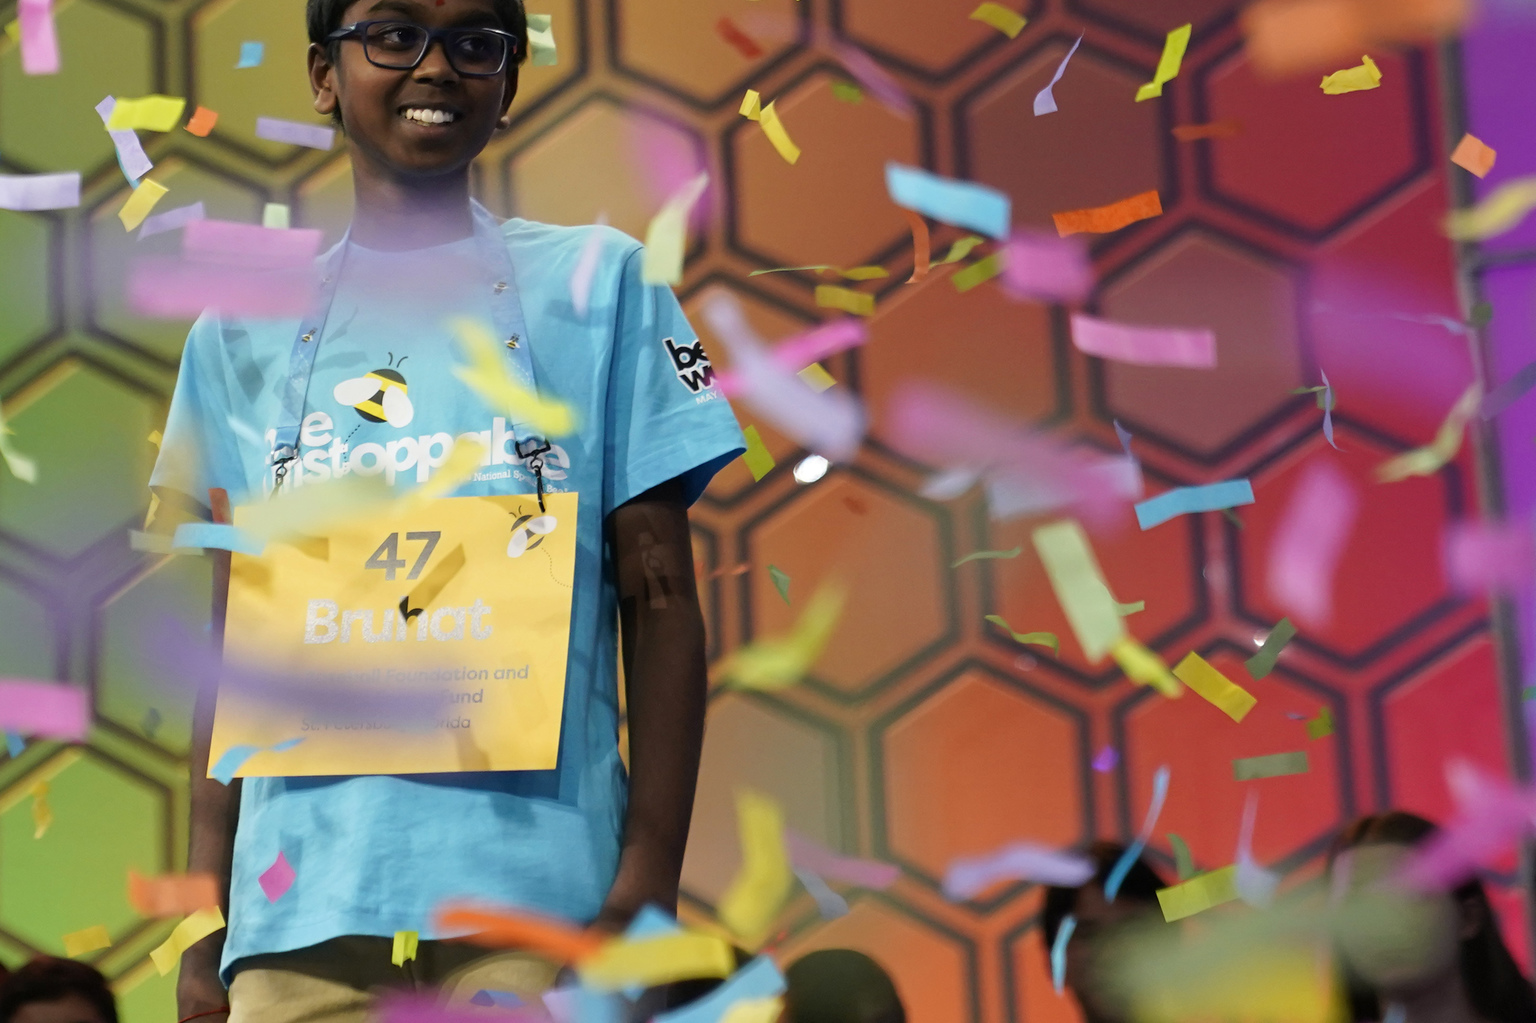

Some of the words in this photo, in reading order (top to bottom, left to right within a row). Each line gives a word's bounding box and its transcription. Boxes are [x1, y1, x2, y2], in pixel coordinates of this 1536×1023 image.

[695, 390, 719, 405] MAY
[473, 469, 511, 482] National
[364, 530, 442, 581] 47
[303, 595, 494, 645] Bruhat
[386, 664, 489, 684] Foundation
[493, 664, 530, 681] and
